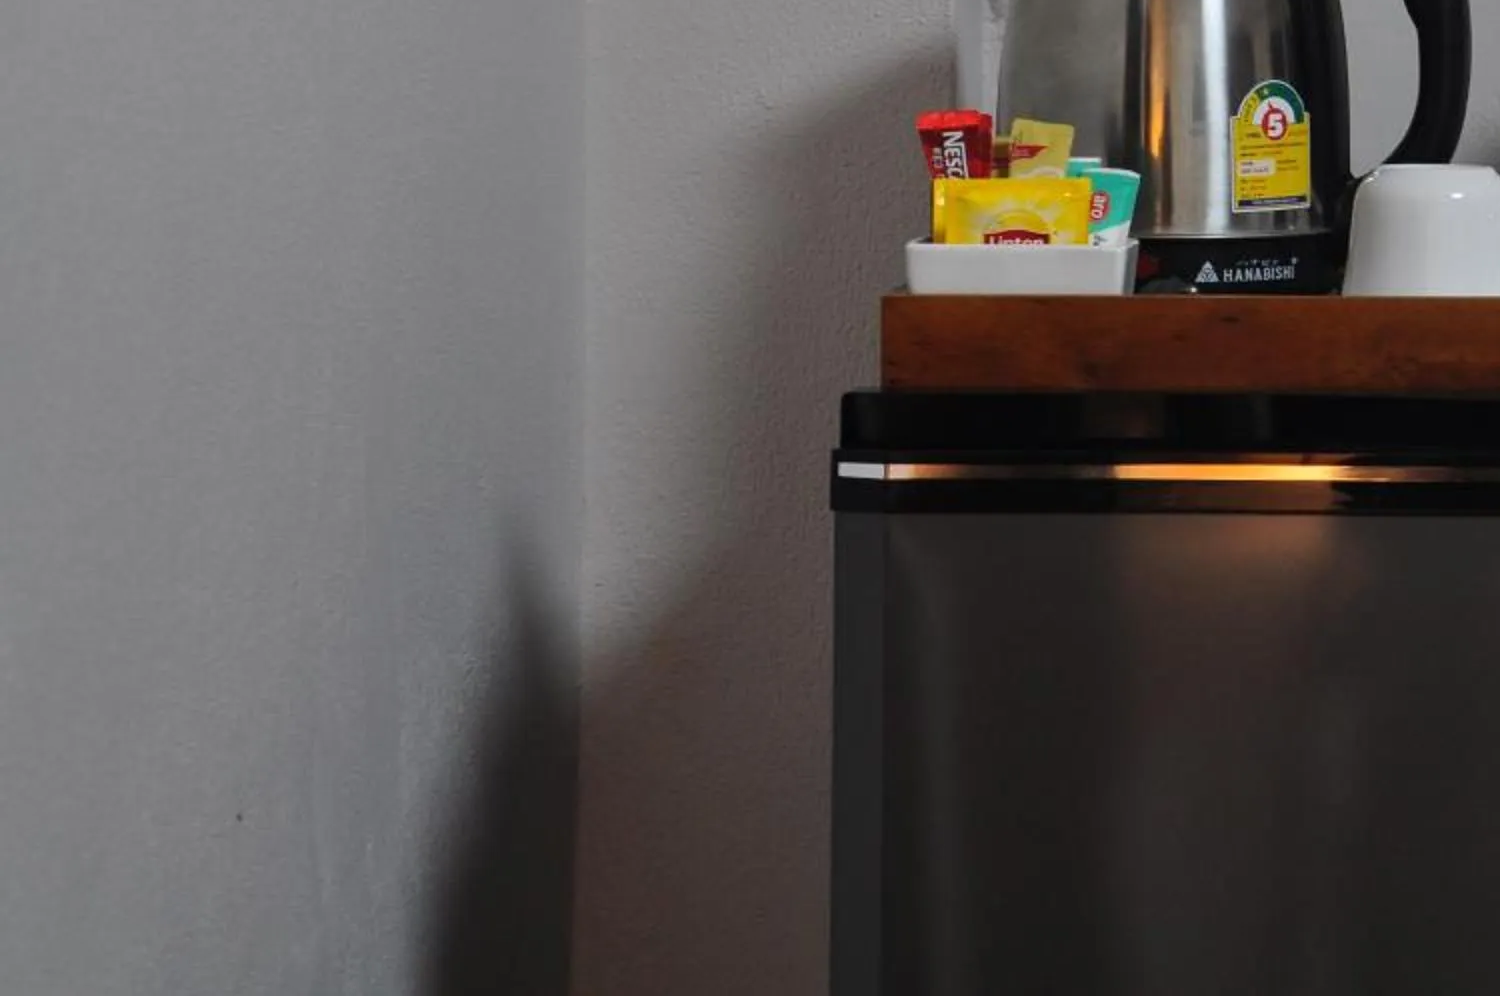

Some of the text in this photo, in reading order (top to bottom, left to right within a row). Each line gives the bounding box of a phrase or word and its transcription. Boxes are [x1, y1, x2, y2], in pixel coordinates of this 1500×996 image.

[1268, 113, 1284, 136] 5
[942, 131, 969, 179] NESC
[1223, 265, 1295, 283] HANABISHI
